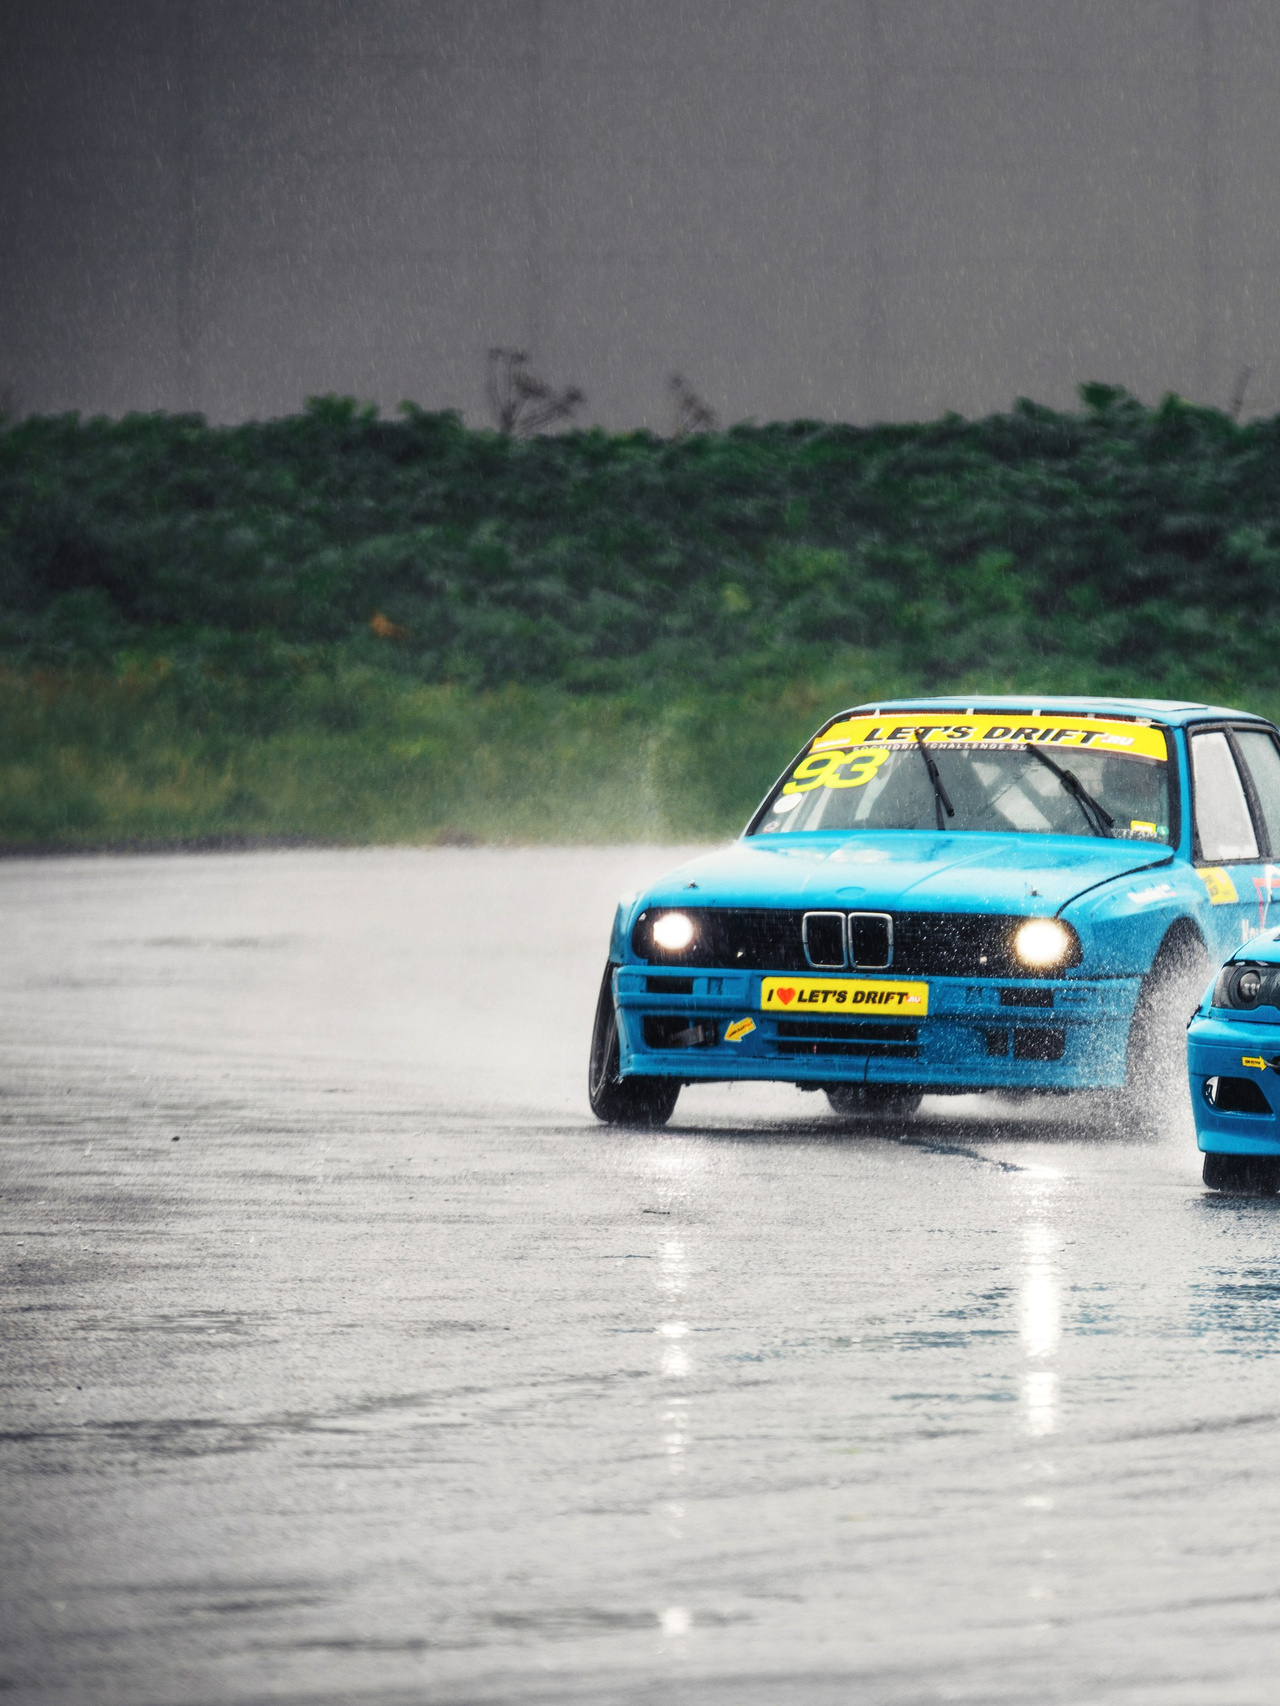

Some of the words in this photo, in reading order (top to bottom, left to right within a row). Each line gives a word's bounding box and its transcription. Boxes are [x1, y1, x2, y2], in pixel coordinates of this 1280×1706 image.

[863, 725, 976, 743] LET'S
[782, 749, 890, 795] 93
[766, 989, 774, 1002] I
[797, 989, 848, 1003] LET'S
